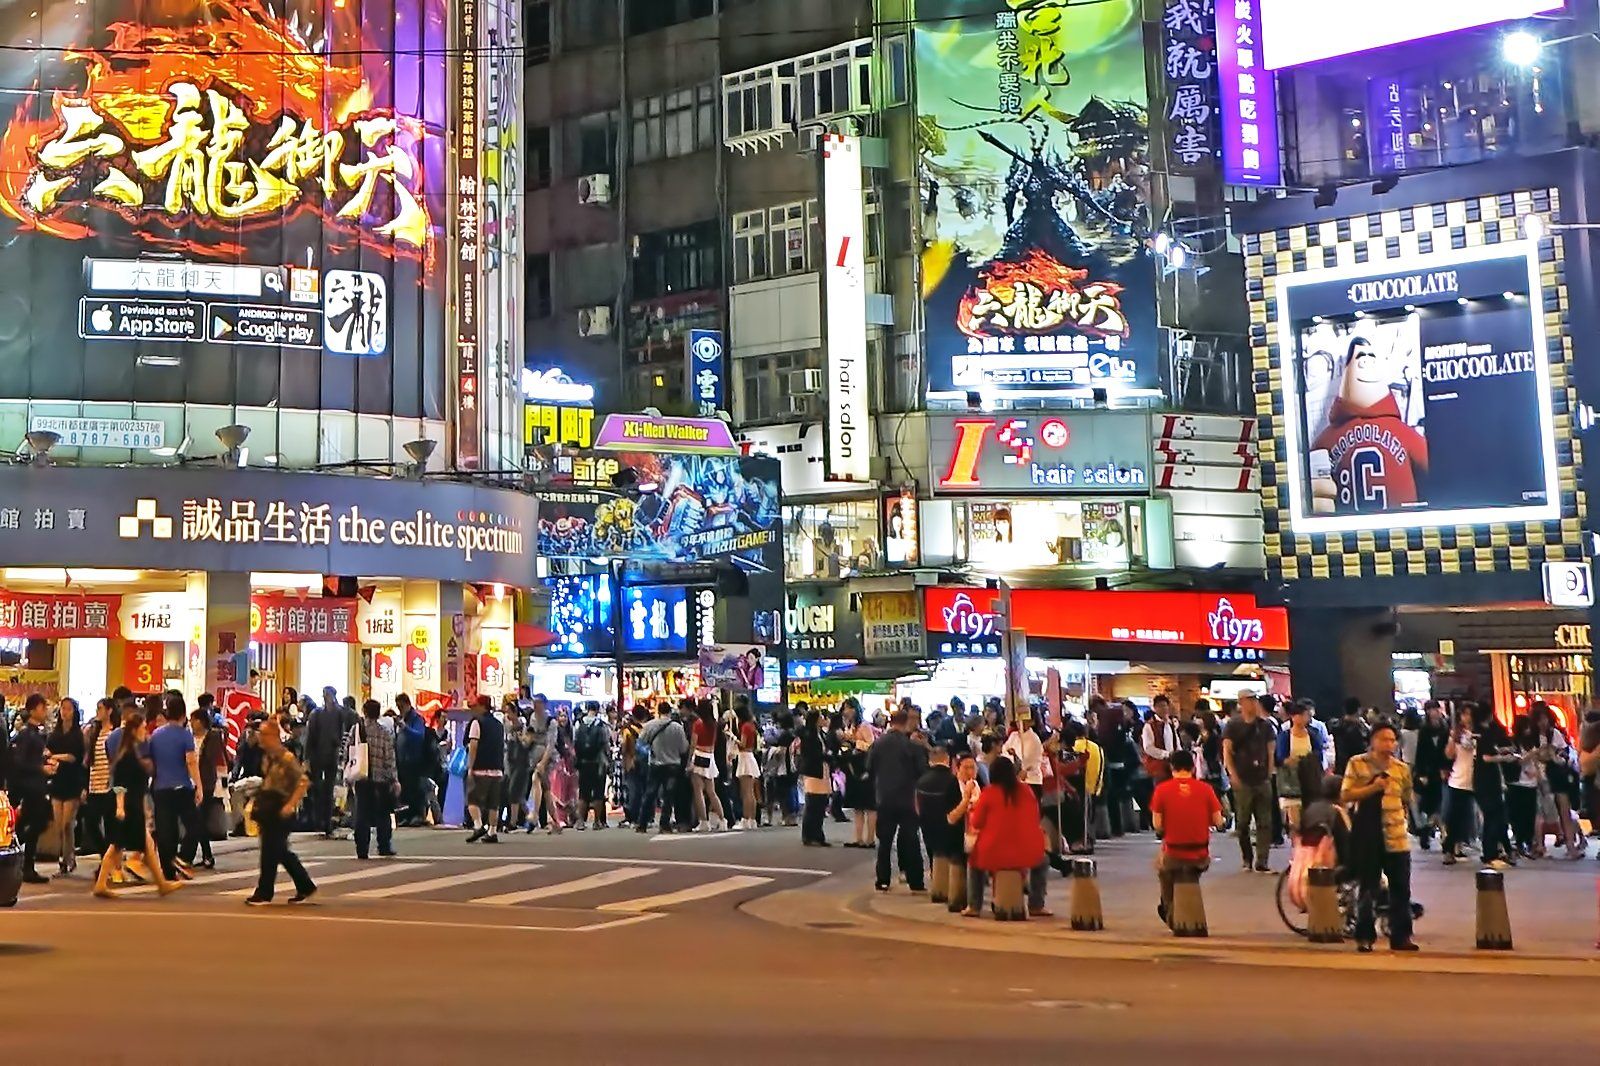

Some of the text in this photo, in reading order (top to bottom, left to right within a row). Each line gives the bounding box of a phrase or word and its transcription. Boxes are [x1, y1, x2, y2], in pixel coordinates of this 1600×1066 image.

[24, 82, 428, 246] 六龍御天
[460, 175, 477, 262] 翰林茶館
[130, 268, 223, 290] 六龍御天
[120, 304, 161, 316] Download
[166, 309, 178, 317] on
[238, 309, 276, 320] ANDROID
[968, 281, 1124, 332] 六龍御天
[119, 316, 196, 336] App Store
[237, 320, 314, 344] Google play
[839, 358, 856, 459] hair salon
[524, 404, 595, 448] 門町
[666, 424, 709, 441] Walker
[1031, 463, 1145, 485] hair salon
[0, 507, 86, 530] 館拍賣
[182, 496, 523, 562] 誠品生活 the eslite spectrum
[131, 612, 172, 630] 1折起
[265, 606, 350, 635] 封館拍賣
[366, 618, 394, 634] 1折起
[138, 664, 152, 684] 3
